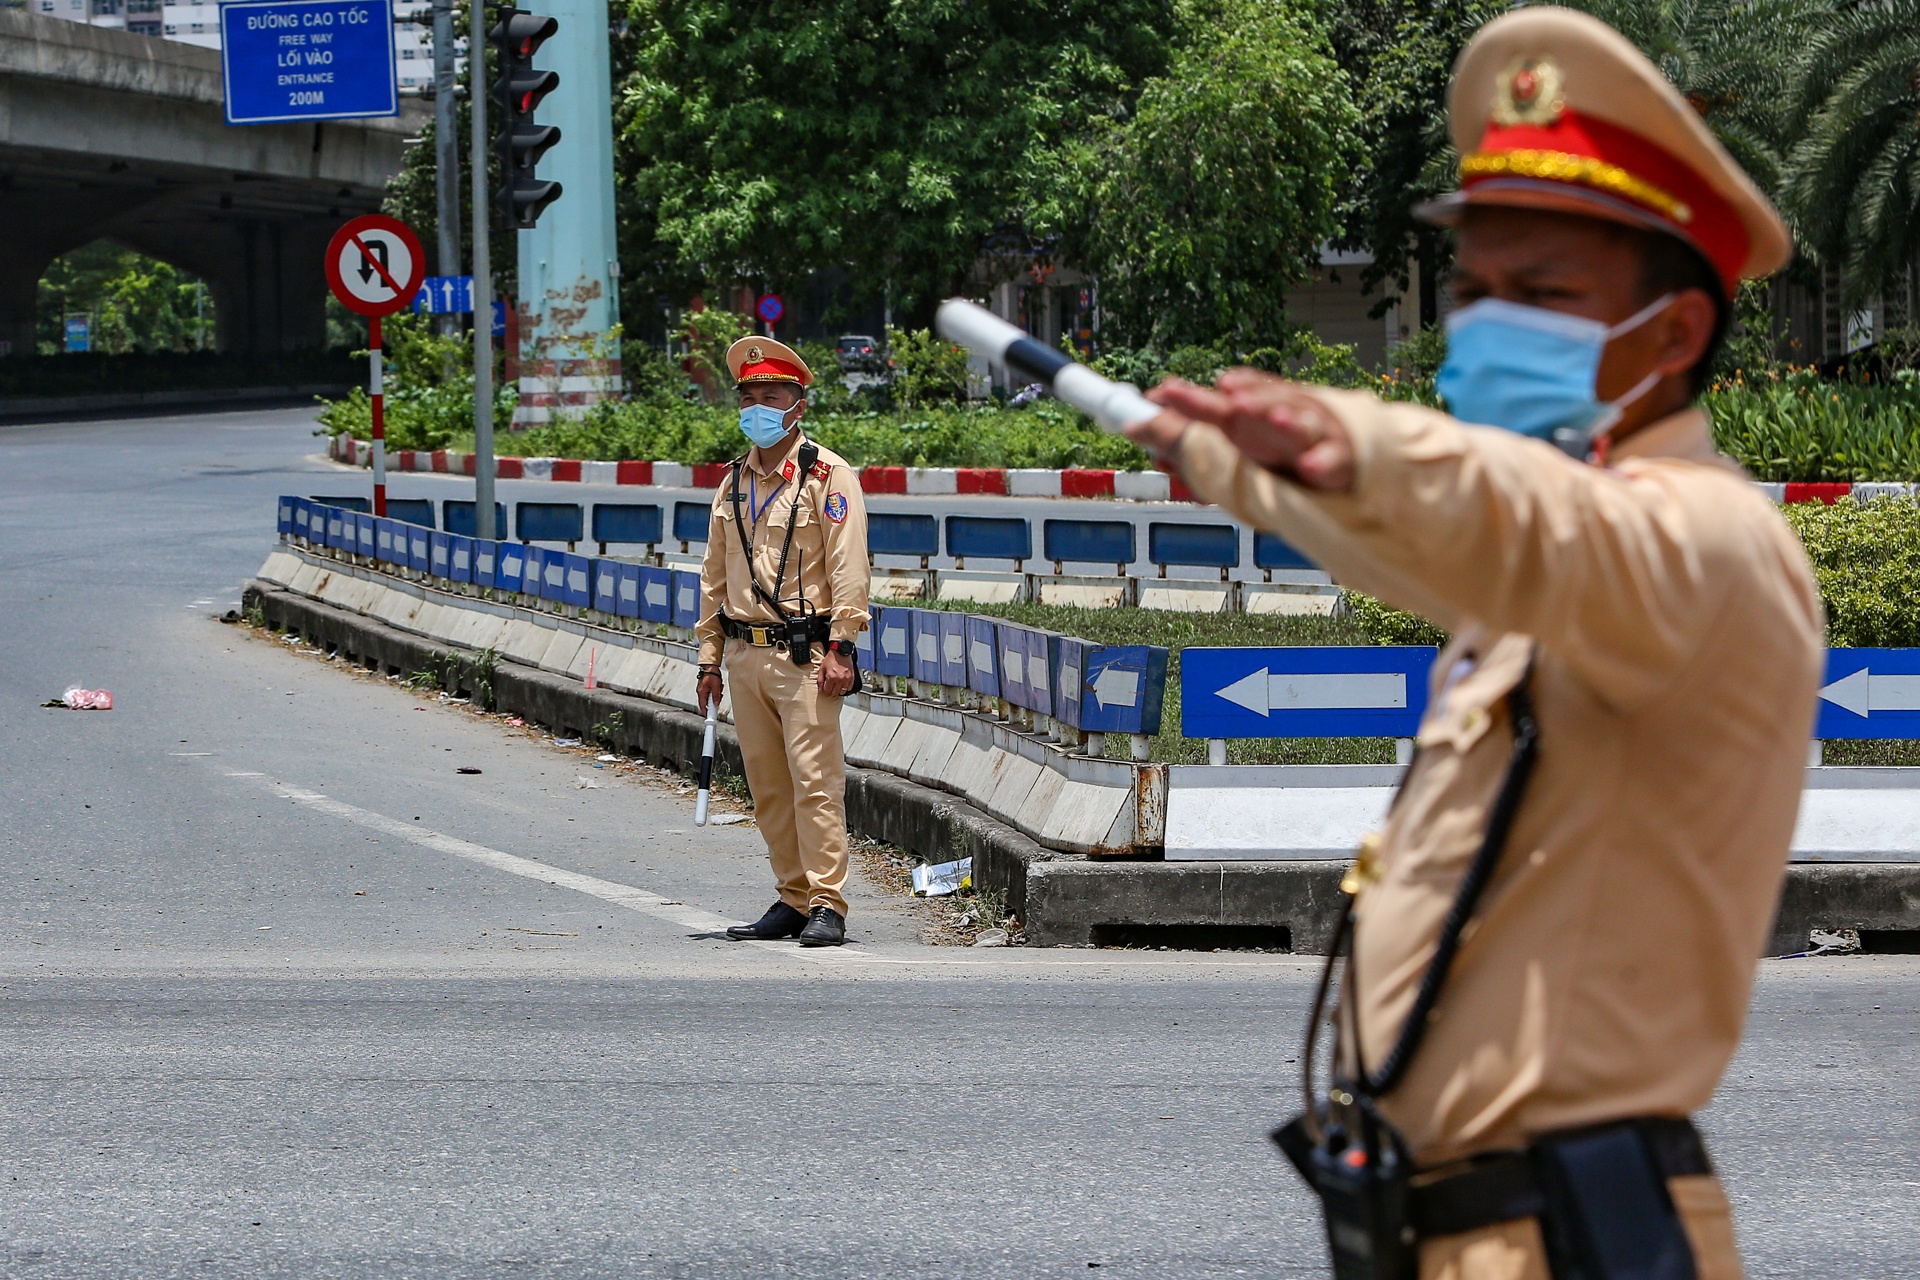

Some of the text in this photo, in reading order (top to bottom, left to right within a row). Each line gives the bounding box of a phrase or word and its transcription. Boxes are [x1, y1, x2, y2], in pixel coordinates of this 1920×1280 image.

[247, 6, 368, 30] ĐƯỜNG CAO TỐC
[279, 33, 333, 46] FREE WAY
[278, 47, 333, 67] LỐI VÀO
[278, 72, 334, 86] ENTRANCE
[289, 91, 324, 106] 200M
